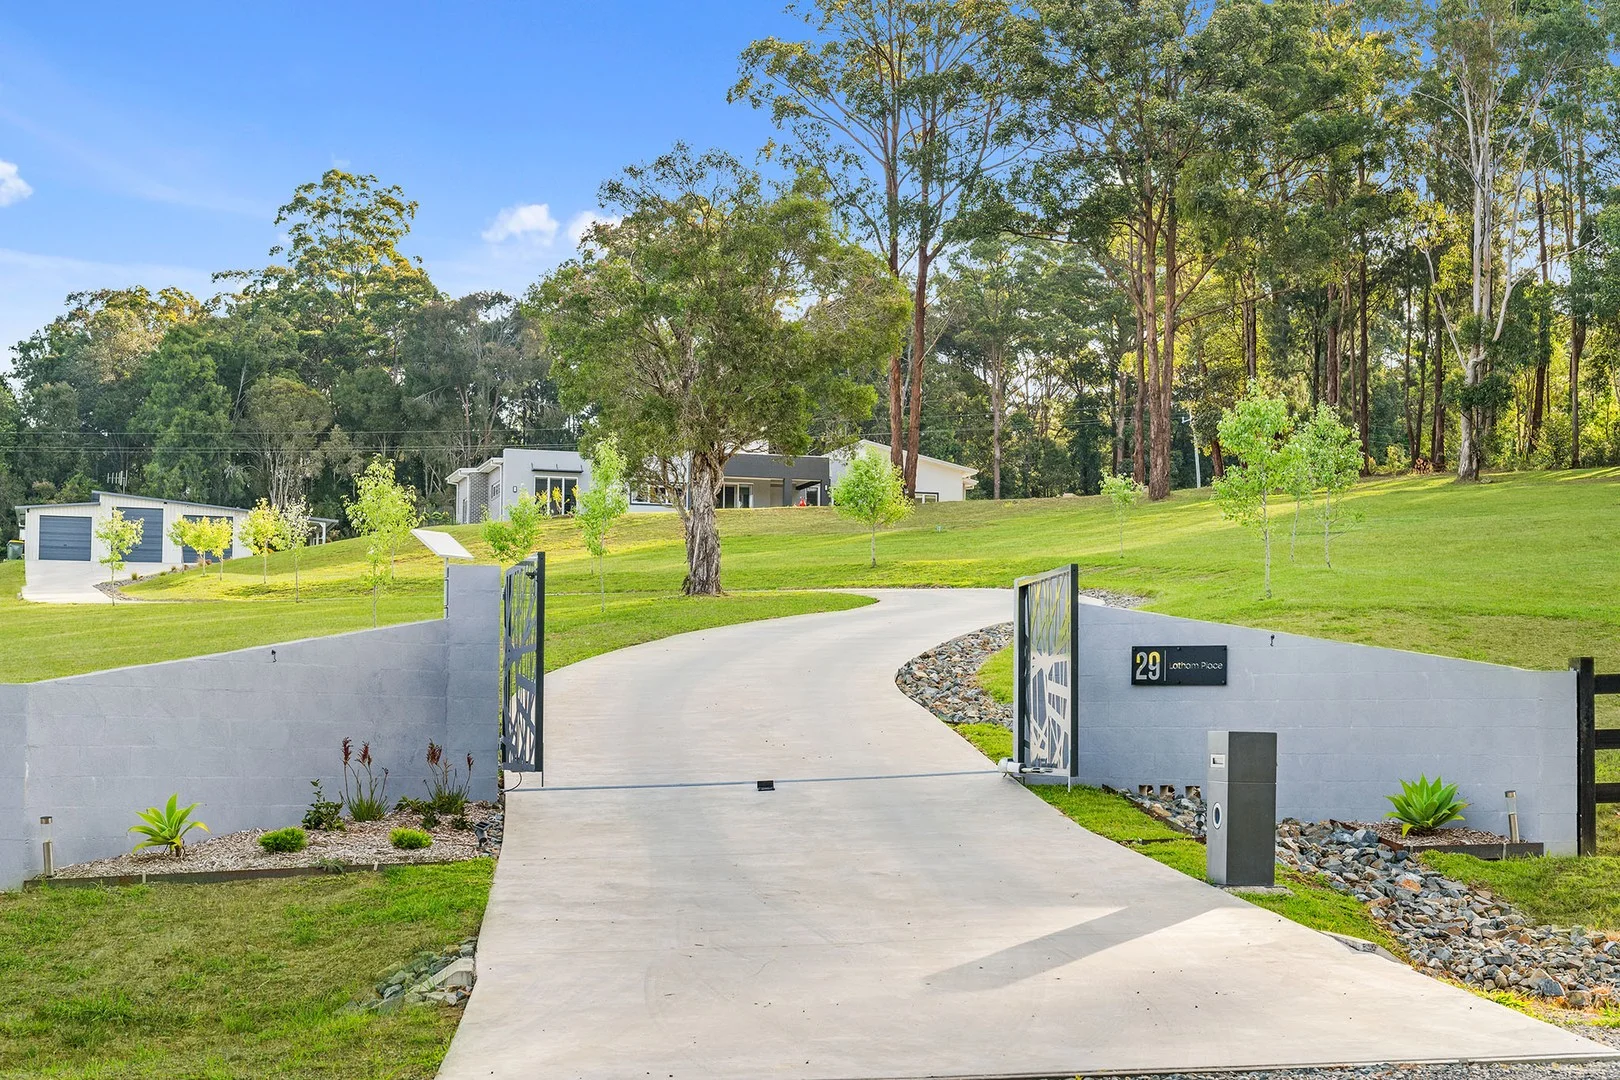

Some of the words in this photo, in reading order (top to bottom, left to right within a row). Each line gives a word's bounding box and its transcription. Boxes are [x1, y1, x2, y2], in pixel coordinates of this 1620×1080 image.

[1135, 651, 1160, 680] 29
[1169, 661, 1199, 670] Latham
[1201, 661, 1223, 670] Place
